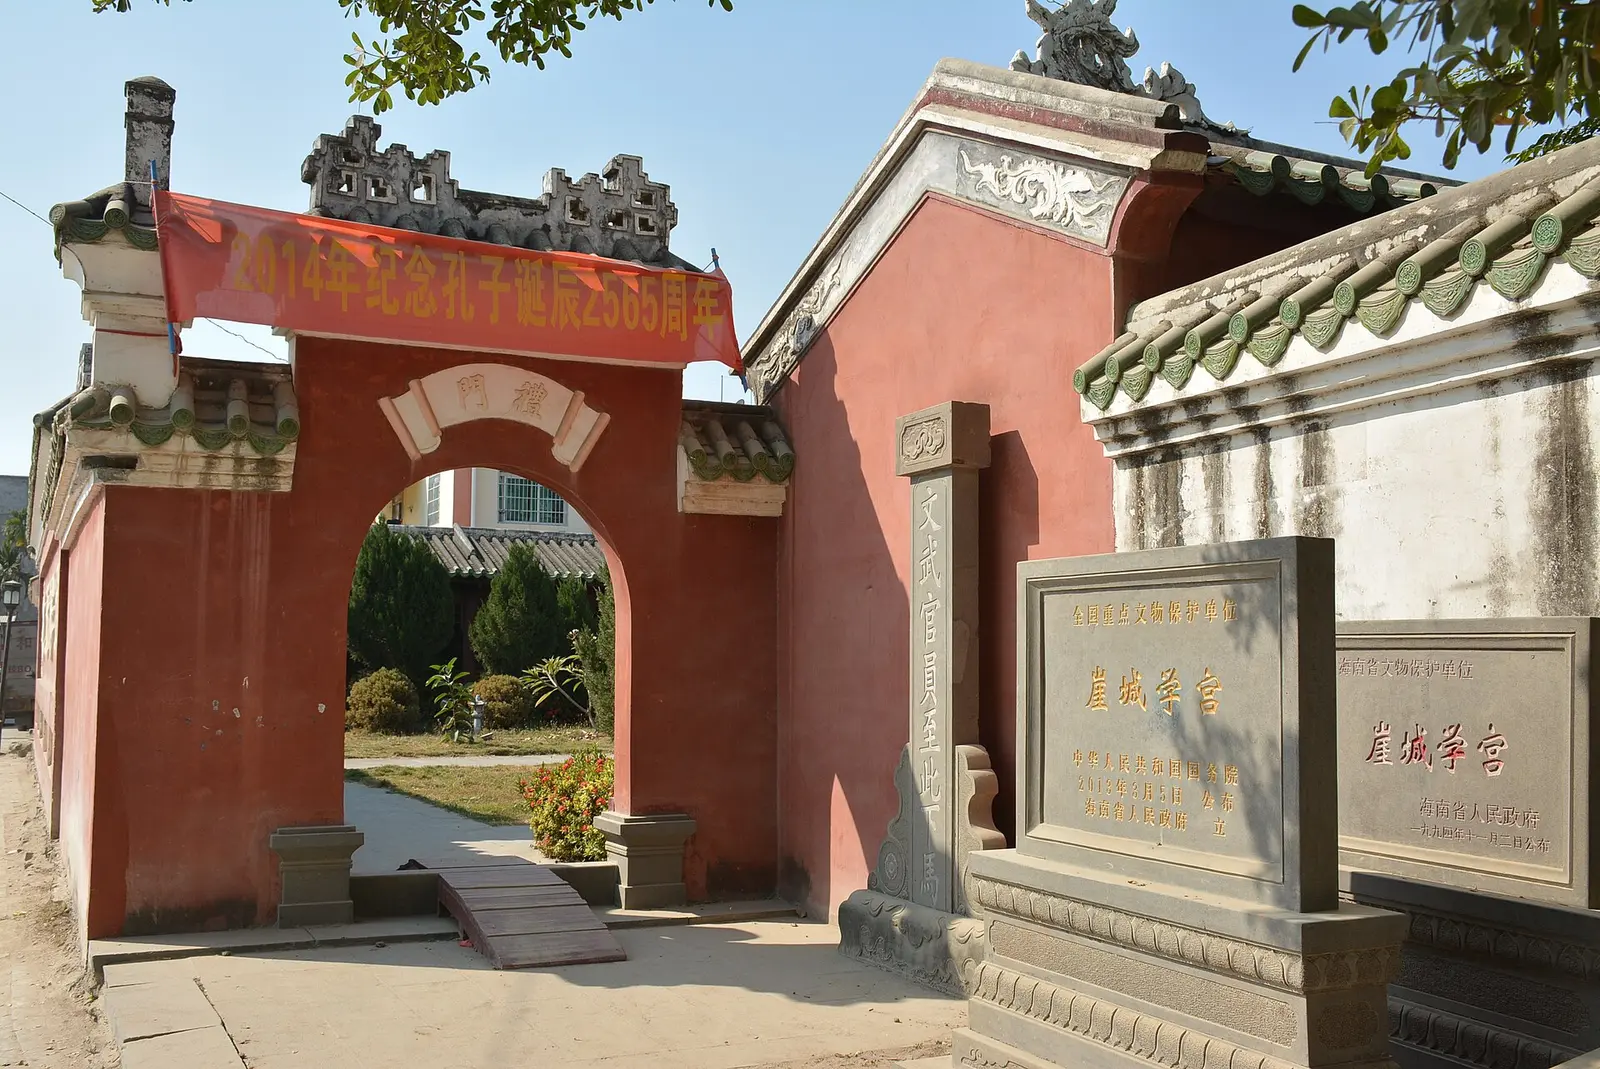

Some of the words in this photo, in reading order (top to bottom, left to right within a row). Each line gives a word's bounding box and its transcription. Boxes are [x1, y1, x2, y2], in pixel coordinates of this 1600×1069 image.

[230, 229, 724, 342] 2014年纪念孔子诞辰2565周年
[1072, 598, 1239, 627] 全国重点文物保护单位
[1338, 656, 1475, 680] 海南省文物保护单位
[1072, 748, 1240, 787] 中华人民共和国国务院
[1078, 774, 1184, 807] 2013年3月5日
[1084, 797, 1189, 833] 海南省人民政府
[1212, 816, 1227, 838] 立
[1419, 796, 1541, 831] 海南省人民政府
[1409, 820, 1551, 854] 一九九四年十一月二日公布
